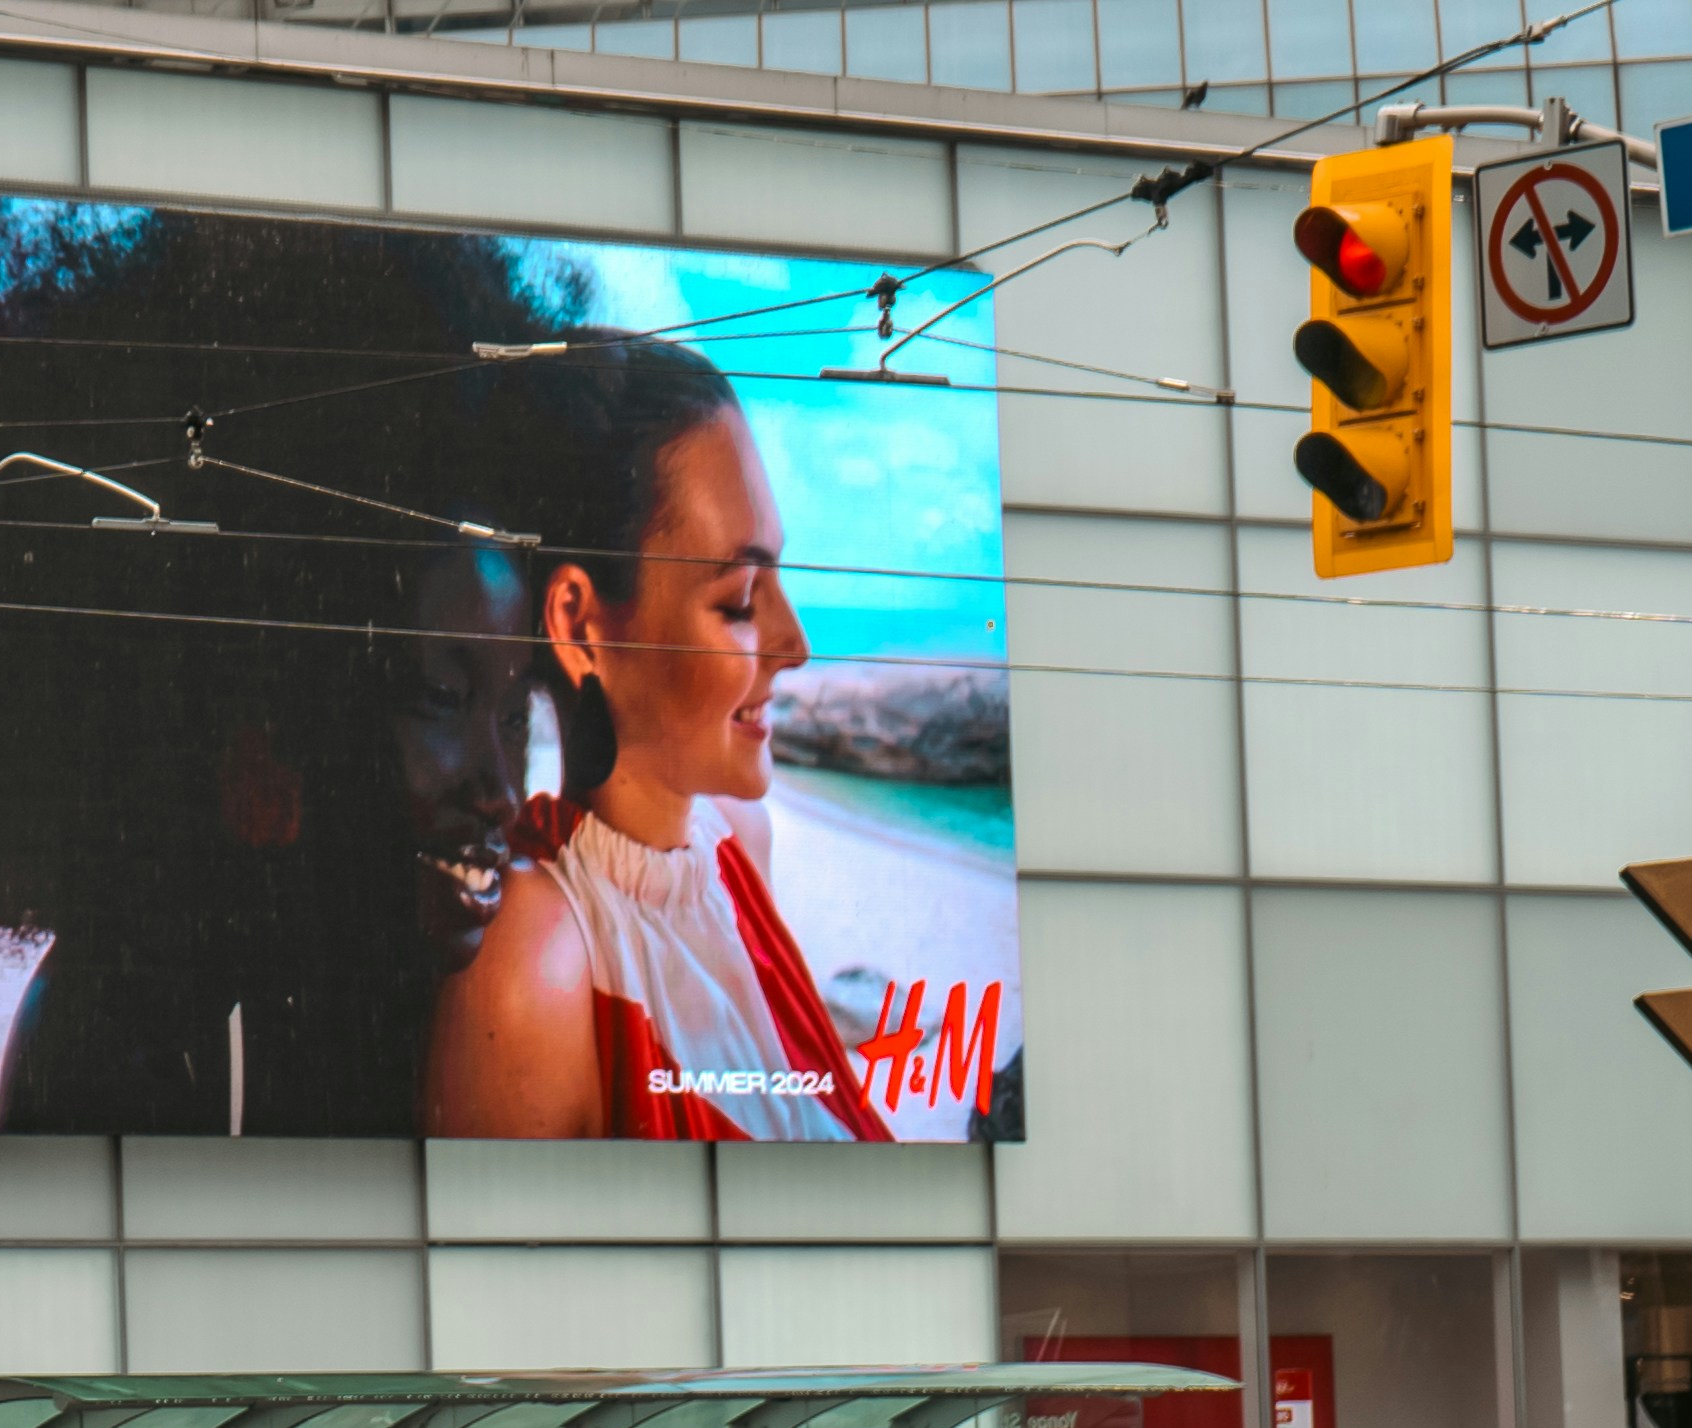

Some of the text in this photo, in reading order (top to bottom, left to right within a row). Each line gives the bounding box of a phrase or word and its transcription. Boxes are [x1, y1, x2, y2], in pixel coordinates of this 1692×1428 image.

[648, 1068, 835, 1096] SUMMER 2024
[857, 979, 1002, 1116] H&M
